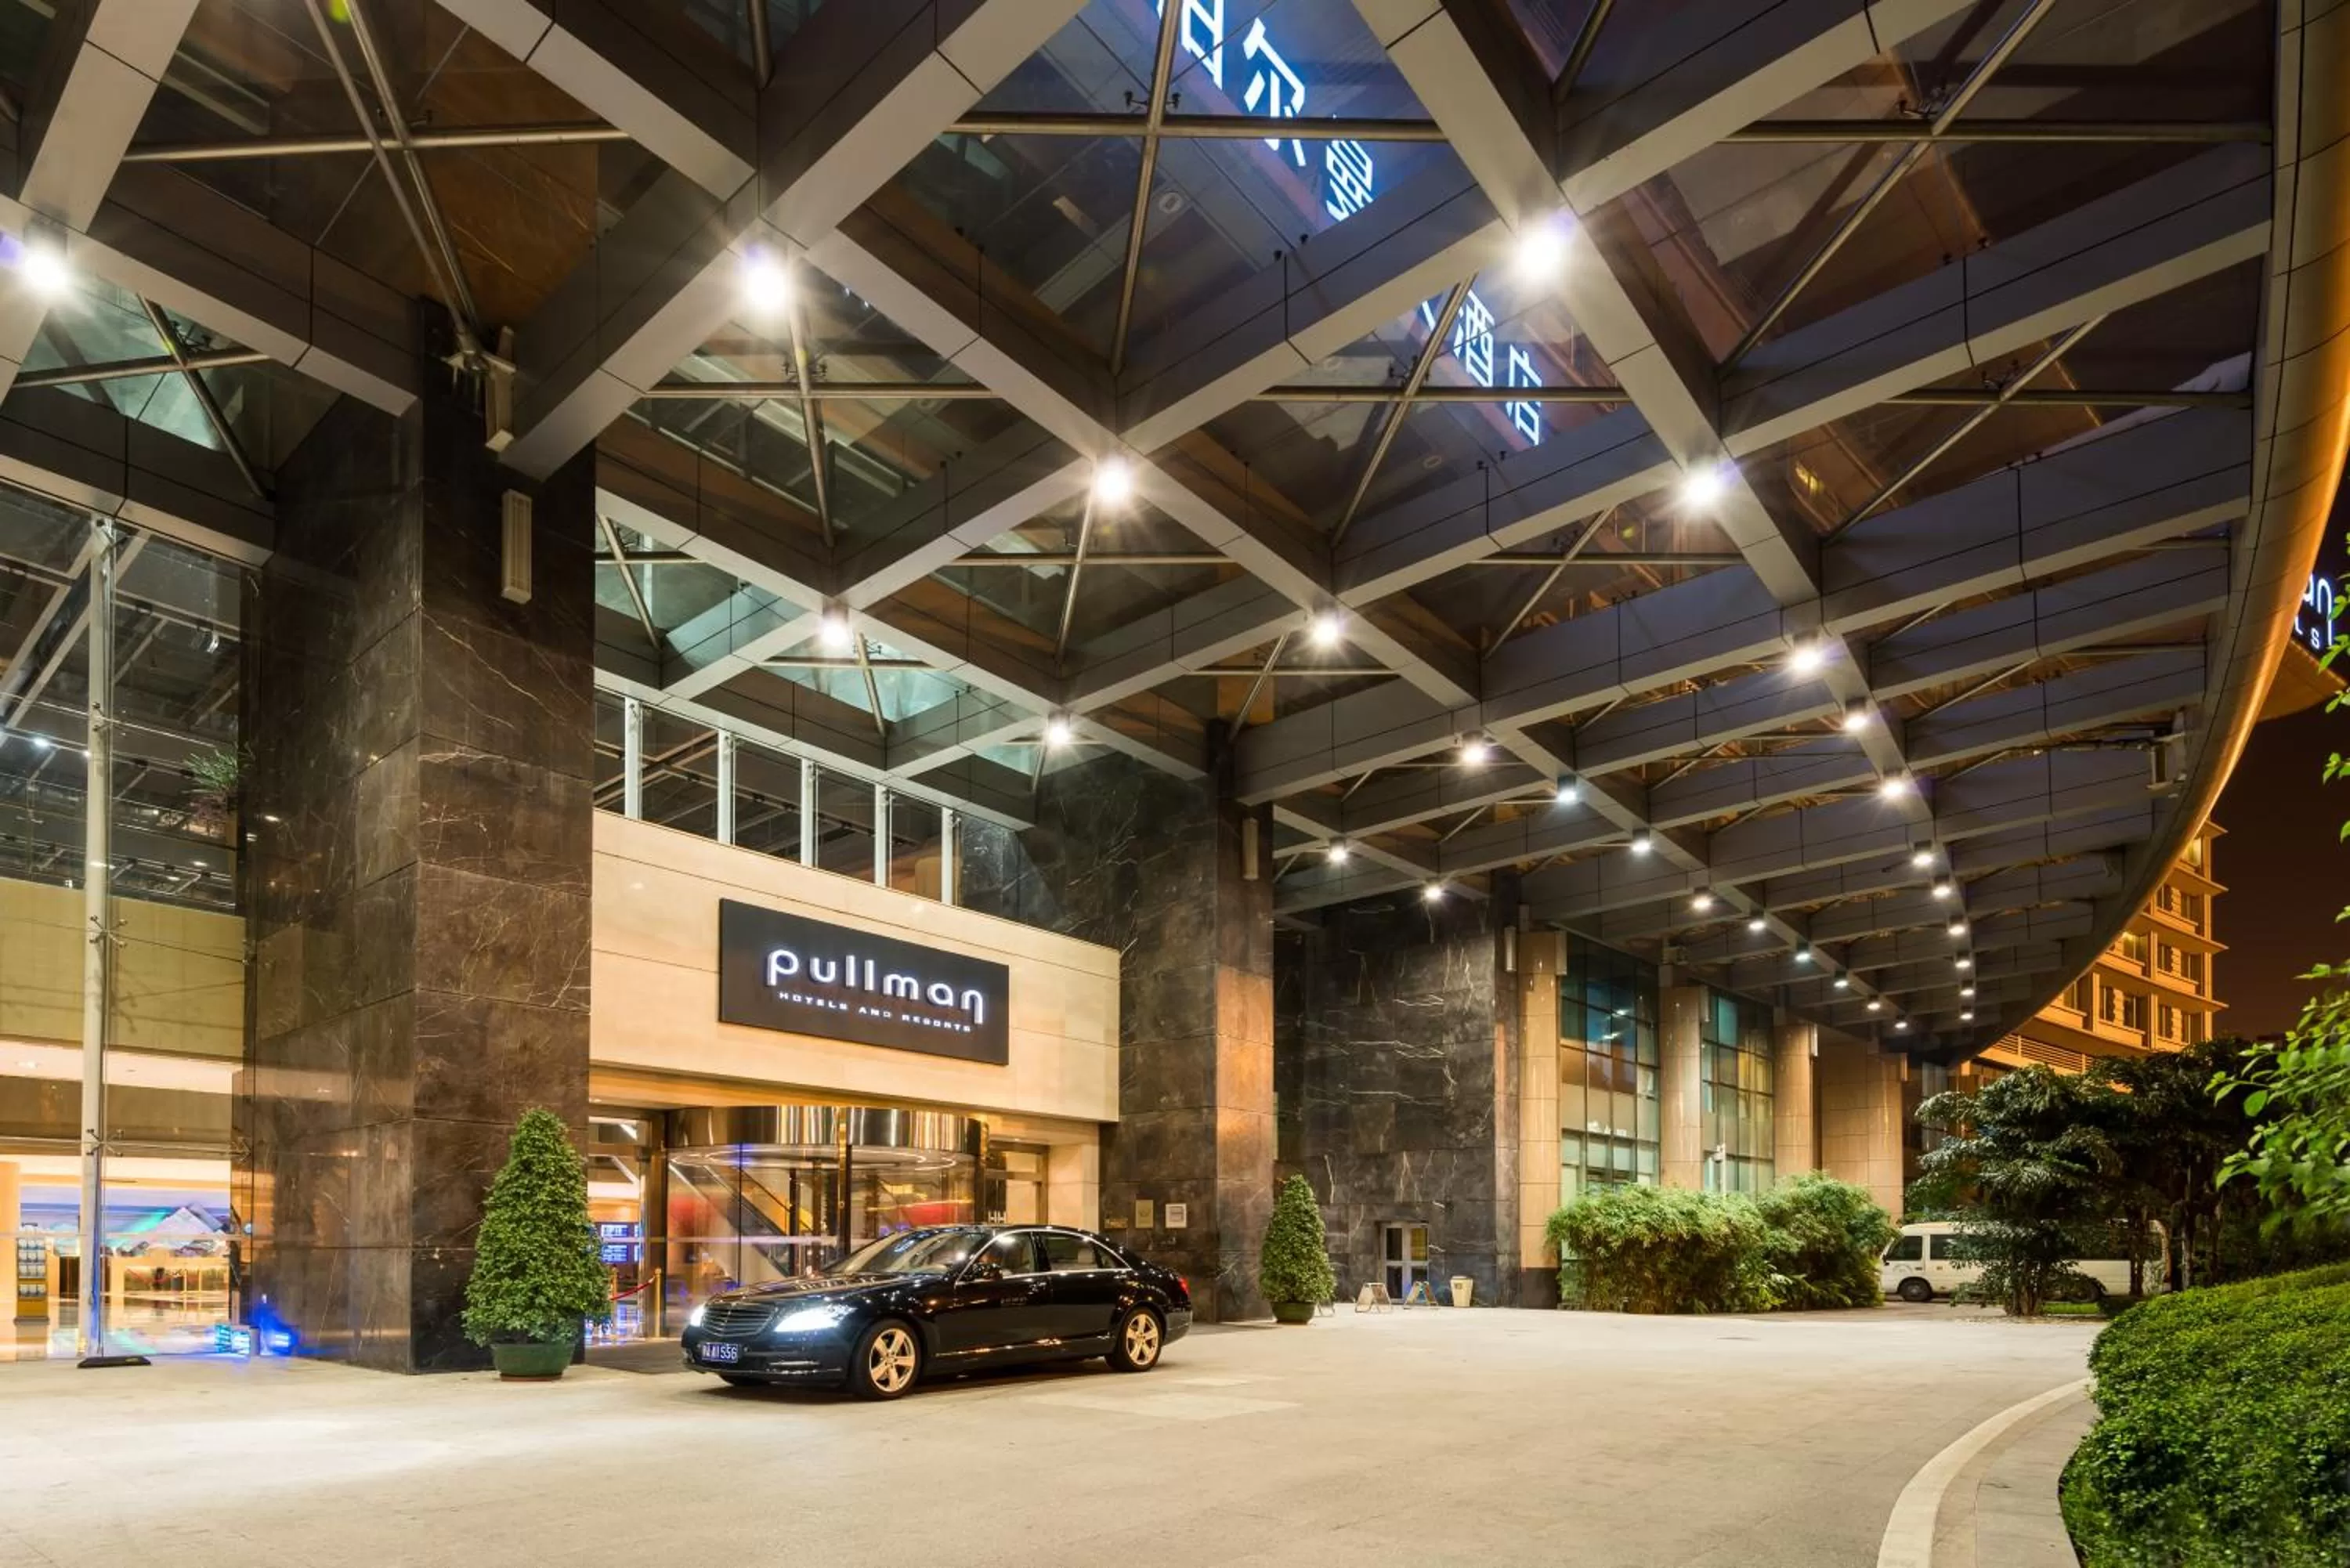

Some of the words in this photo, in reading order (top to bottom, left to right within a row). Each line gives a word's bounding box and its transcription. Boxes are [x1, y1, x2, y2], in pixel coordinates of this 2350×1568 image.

[768, 949, 983, 1024] pullman
[779, 992, 848, 1010] HOTELS
[858, 1006, 891, 1018] AND
[902, 1013, 971, 1033] RESORTS
